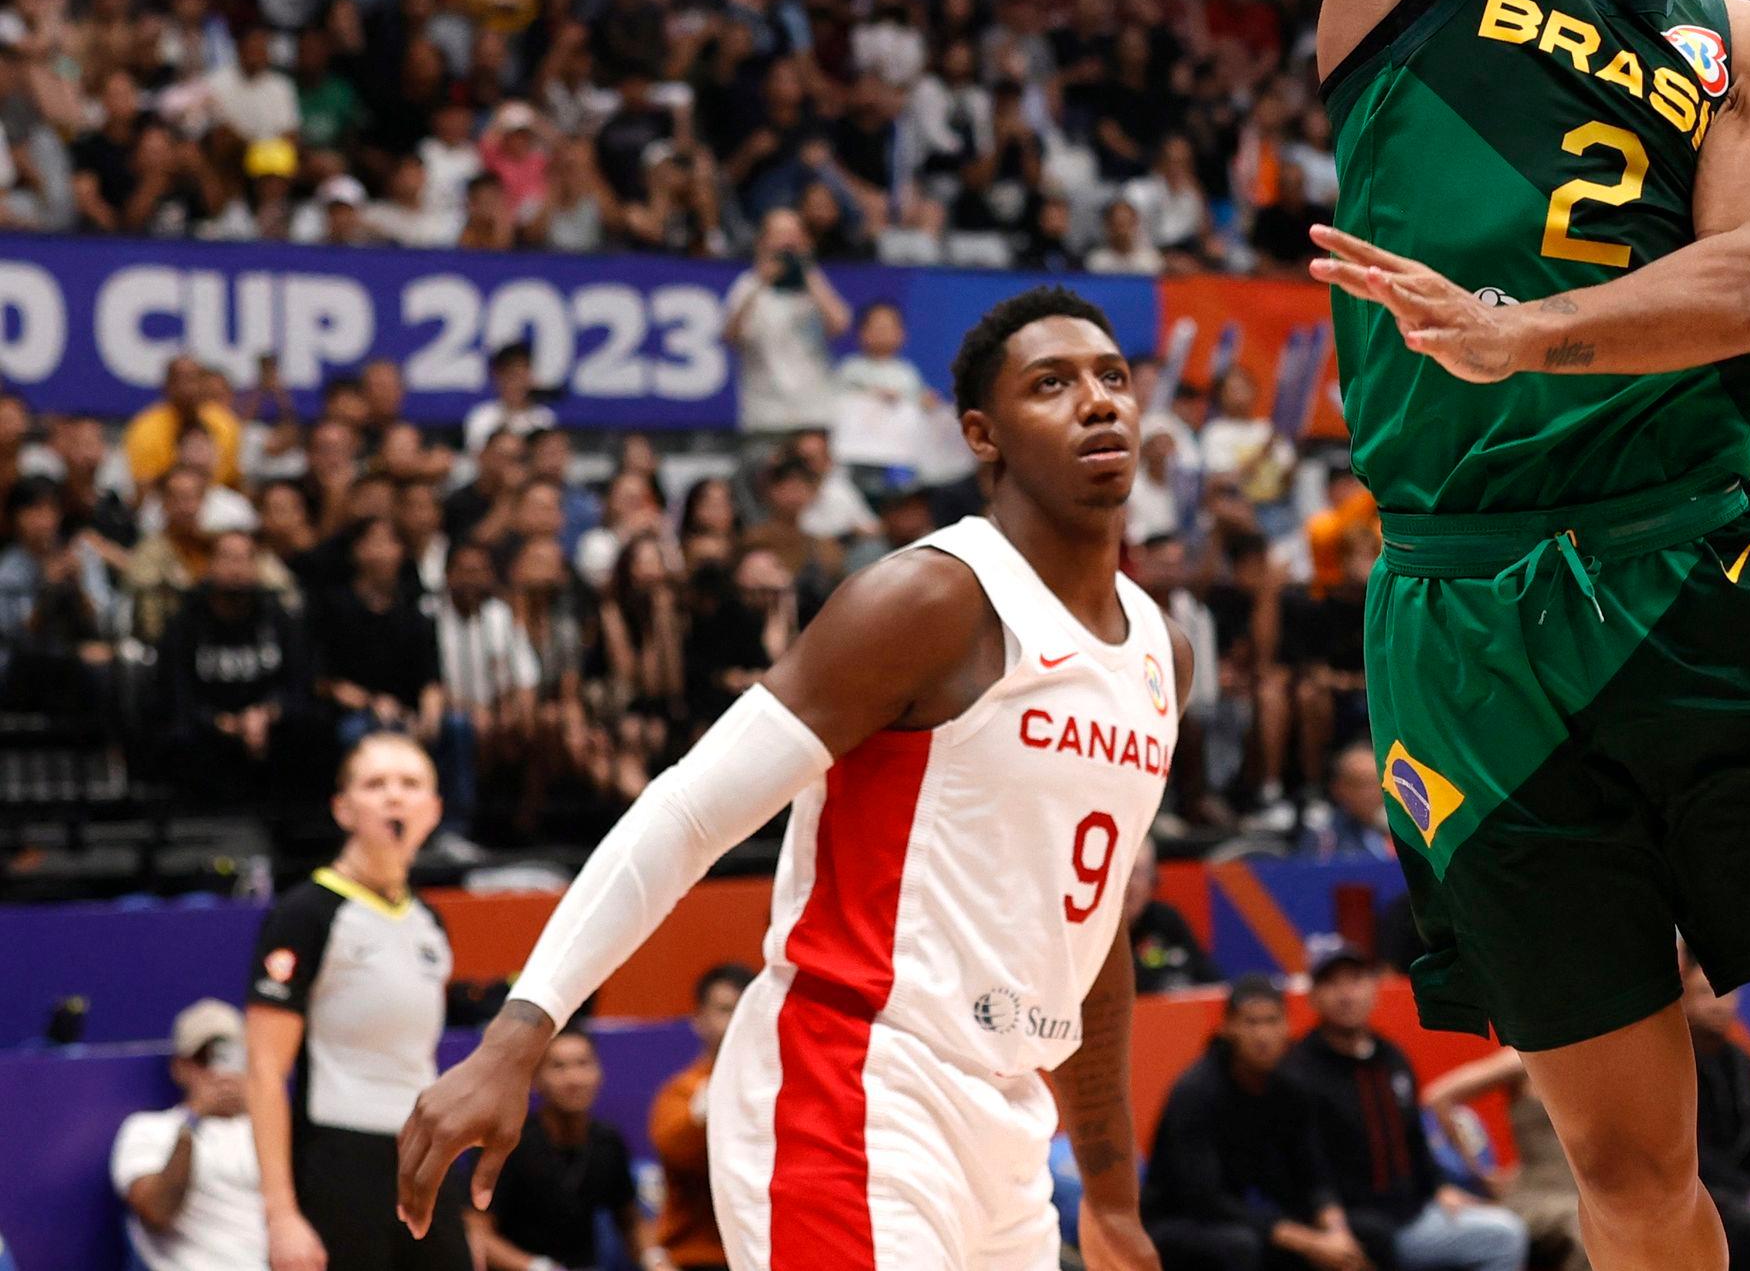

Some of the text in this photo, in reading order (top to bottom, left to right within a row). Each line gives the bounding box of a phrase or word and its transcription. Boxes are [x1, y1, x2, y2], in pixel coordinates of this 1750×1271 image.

[1539, 119, 1650, 269] 2
[94, 262, 376, 392] CUP
[402, 272, 732, 402] 2023
[1064, 810, 1119, 924] 9
[1025, 1006, 1072, 1040] Sun
